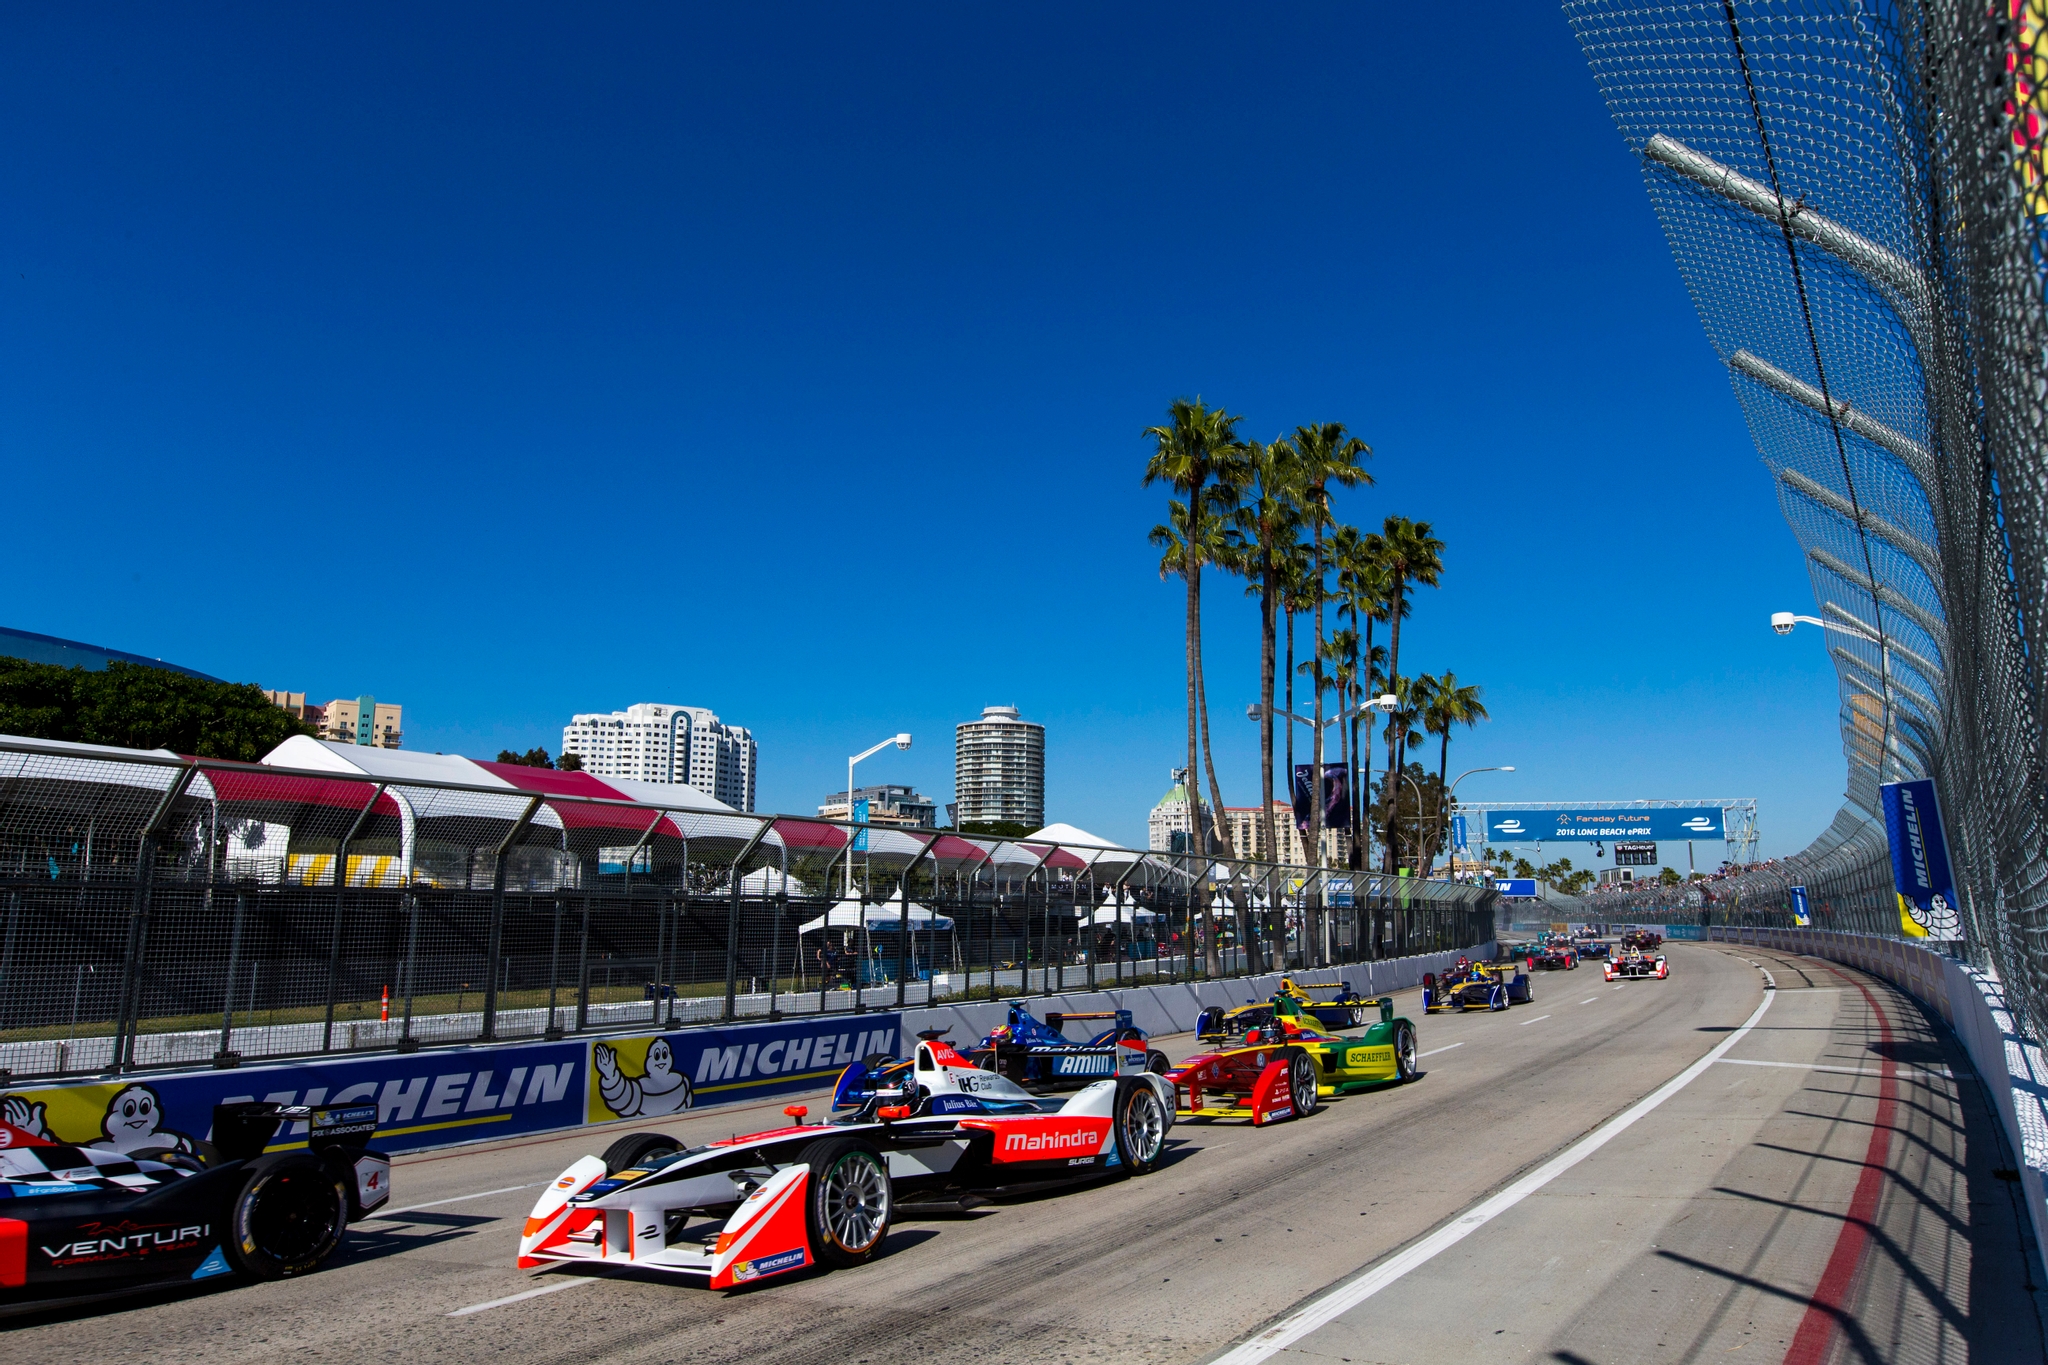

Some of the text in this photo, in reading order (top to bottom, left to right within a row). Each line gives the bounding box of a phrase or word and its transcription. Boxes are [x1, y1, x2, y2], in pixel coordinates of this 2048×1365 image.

[1576, 814, 1650, 823] Faraday Future
[1556, 827, 1651, 836] 2016 LONG BEACH ePRIX
[1901, 788, 1930, 889] MICHELIN
[695, 1027, 895, 1083] MICHELIN
[937, 1048, 955, 1061] AVIS
[1030, 1045, 1116, 1053] Mahindr
[1350, 1051, 1392, 1063] SCHAEFFLER
[980, 1073, 1000, 1082] Rewards
[957, 1076, 979, 1093] IHG
[981, 1083, 992, 1091] Club
[943, 1099, 965, 1111] Julius
[1166, 1095, 1174, 1111] 23
[1004, 1129, 1098, 1151] Mahindra
[1067, 1156, 1095, 1166] SURGE
[367, 1171, 379, 1190] 4
[28, 1186, 79, 1194] #FanBoost
[41, 1223, 210, 1258] VENTURI
[51, 1240, 198, 1267] FORMULA-E TEAM
[758, 1252, 804, 1270] MICHELIN
